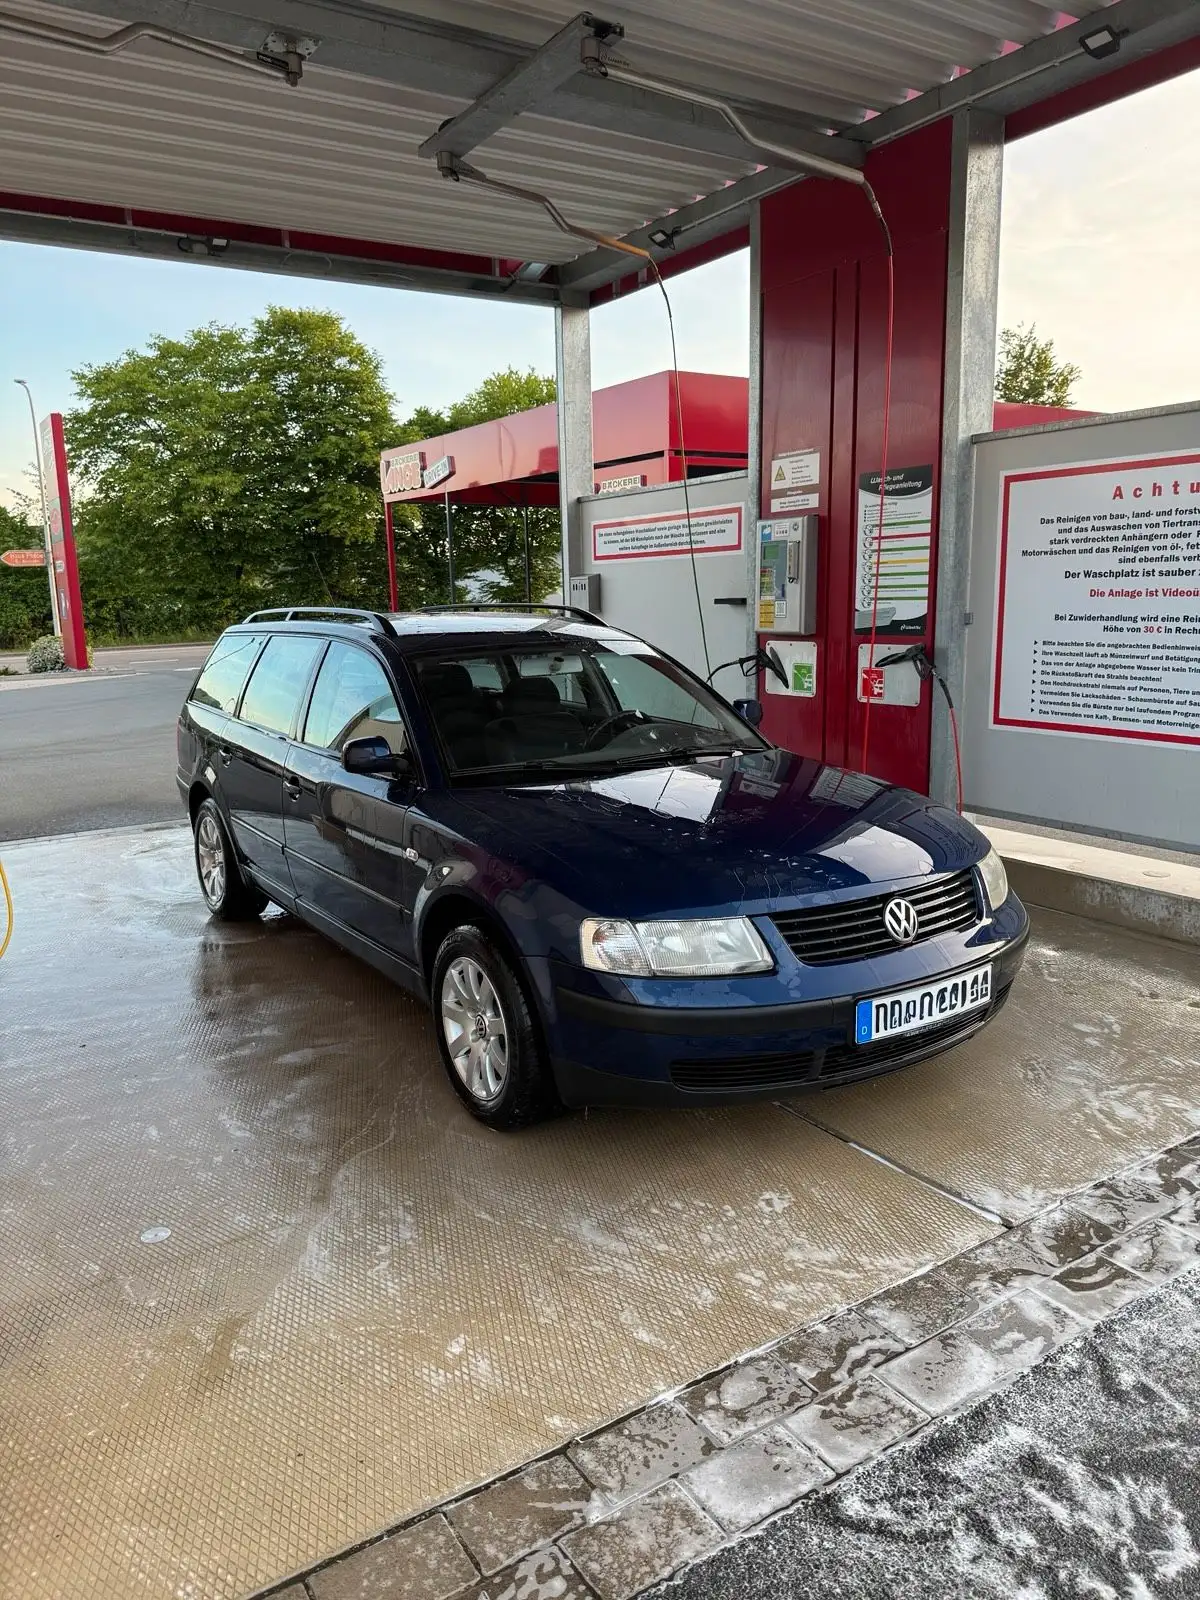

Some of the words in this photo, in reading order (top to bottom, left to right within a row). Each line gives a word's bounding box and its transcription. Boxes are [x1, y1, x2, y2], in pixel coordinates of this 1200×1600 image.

[1056, 514, 1090, 524] Reinigen
[1132, 510, 1154, 518] land-
[1156, 508, 1172, 516] und
[1090, 523, 1142, 533] Auswaschen
[1050, 537, 1069, 545] stark
[1071, 535, 1119, 544] verdreckten
[1121, 532, 1168, 541] Anhängern
[1022, 548, 1076, 556] Motorwäschen
[1112, 544, 1150, 553] Reinigen
[1170, 543, 1184, 551] öl-,
[1138, 555, 1180, 563] ebenfalls
[1065, 570, 1081, 579] Der
[1083, 569, 1139, 579] Waschplatz
[1142, 568, 1156, 577] ist
[1158, 568, 1196, 576] sauber
[1090, 589, 1105, 597] Die
[1108, 589, 1142, 599] Anlage
[1145, 588, 1159, 597] ist
[1068, 614, 1138, 623] Zuwiderhandlung
[1053, 680, 1100, 689] Hochdruckstrahl
[1139, 686, 1172, 694] Personen,
[1082, 692, 1121, 700] Lackschäden
[1128, 696, 1174, 704] Schaumbürste
[1137, 707, 1171, 716] laufendem
[1156, 720, 1200, 729] Motorreinige
[862, 1026, 868, 1035] D
